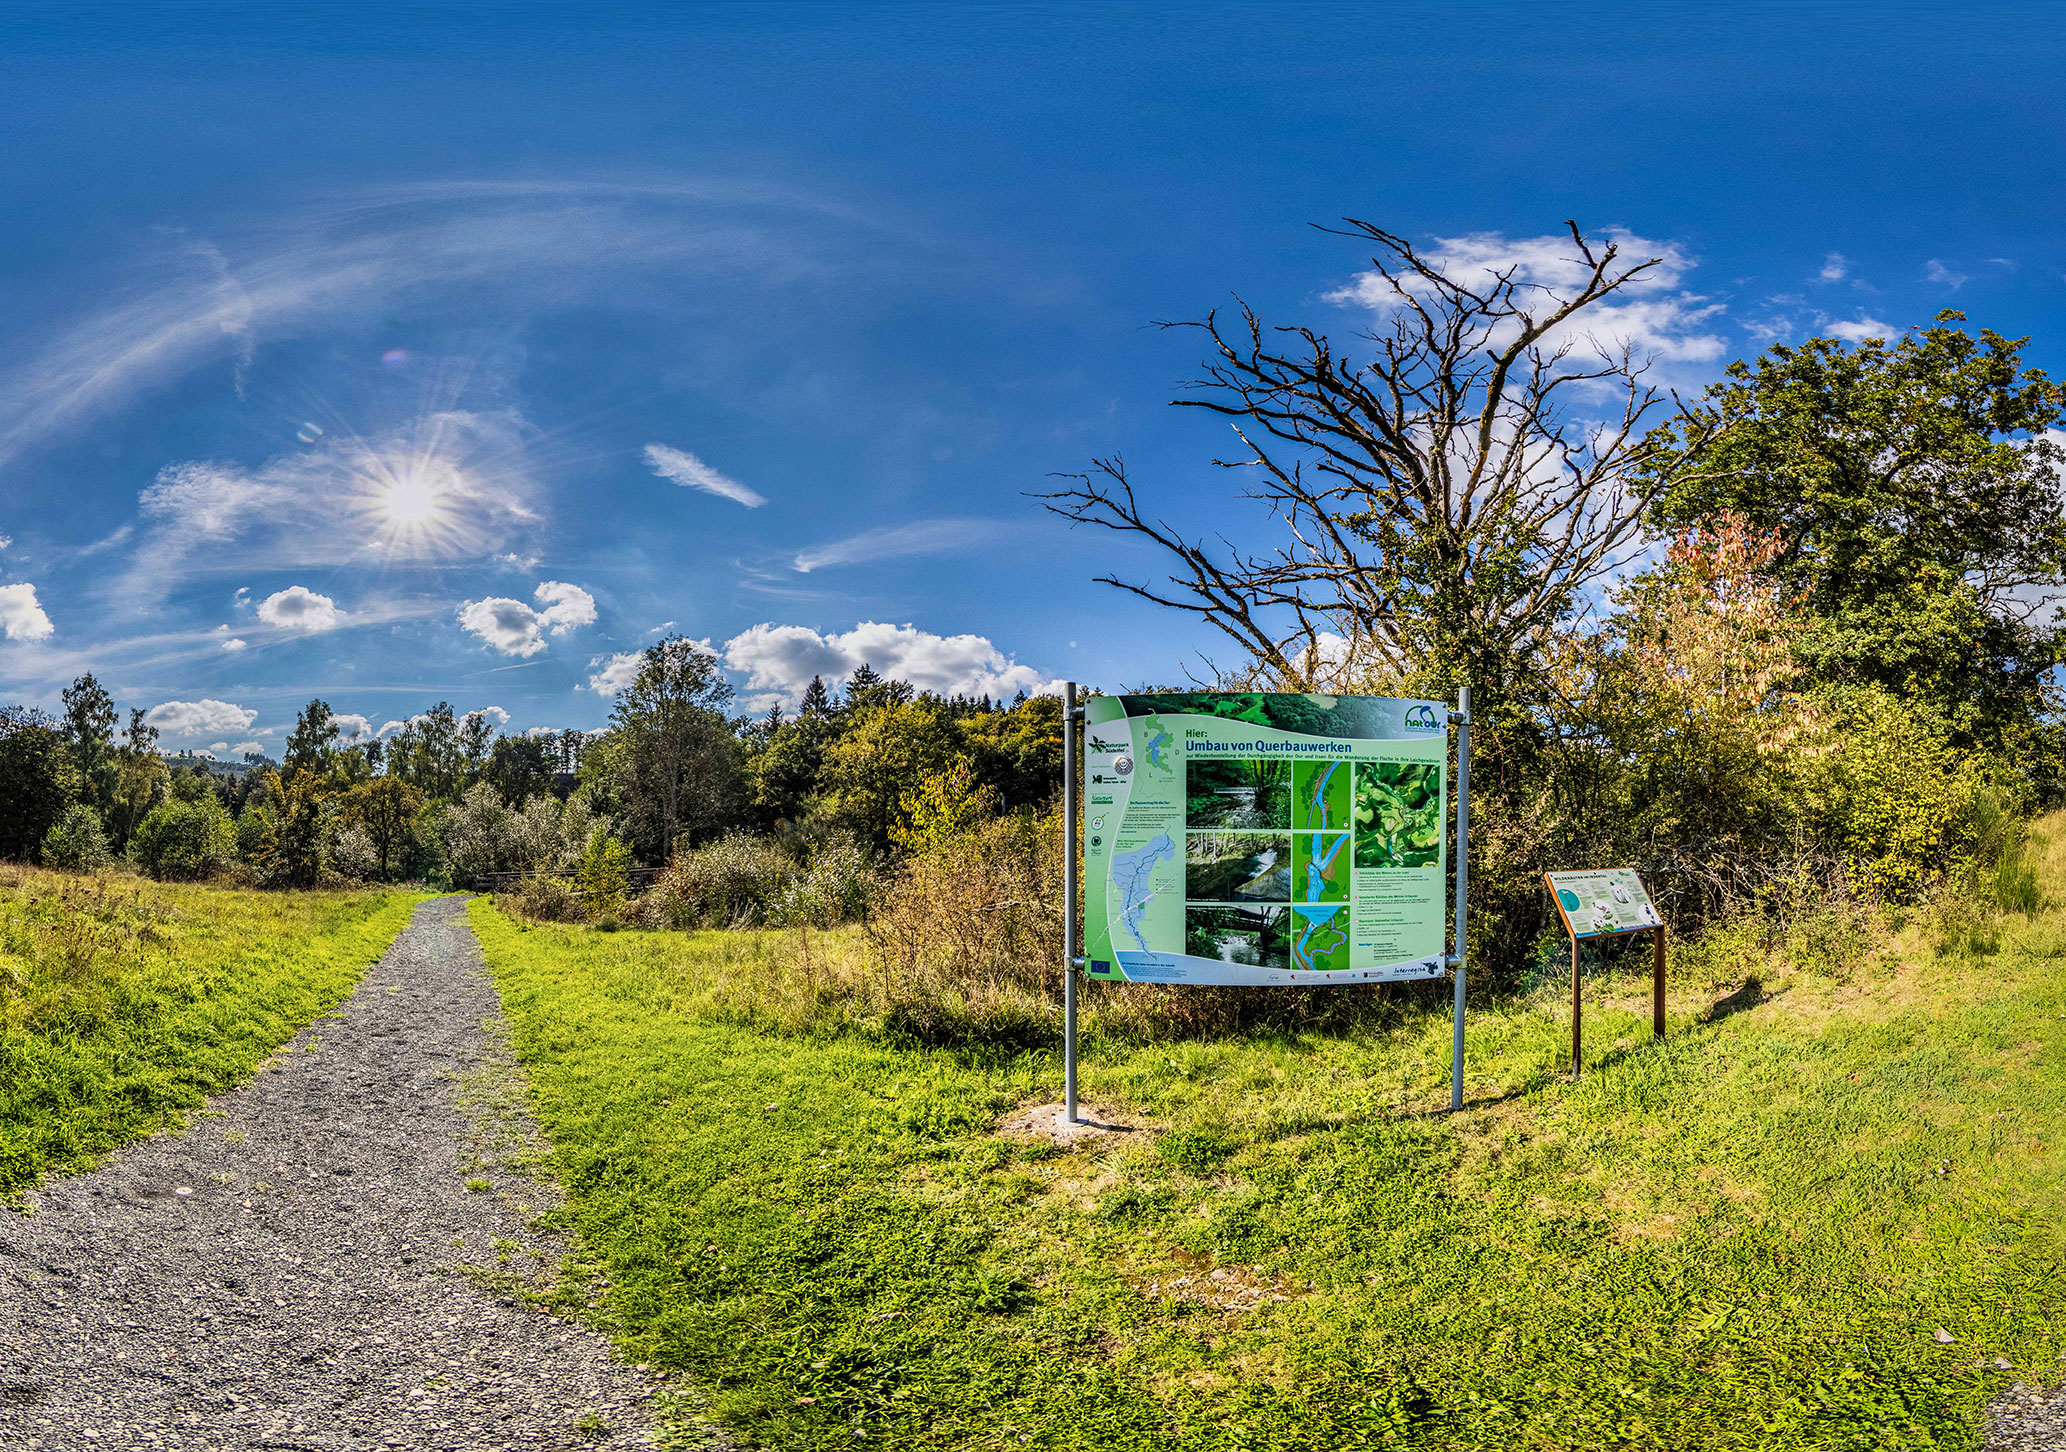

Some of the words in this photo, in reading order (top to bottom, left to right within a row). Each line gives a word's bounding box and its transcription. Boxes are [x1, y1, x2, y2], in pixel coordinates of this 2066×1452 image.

[1185, 729, 1208, 738] Hier:
[1185, 740, 1229, 751] Umbau
[1231, 742, 1253, 751] von
[1255, 740, 1352, 753] Querbauwerken
